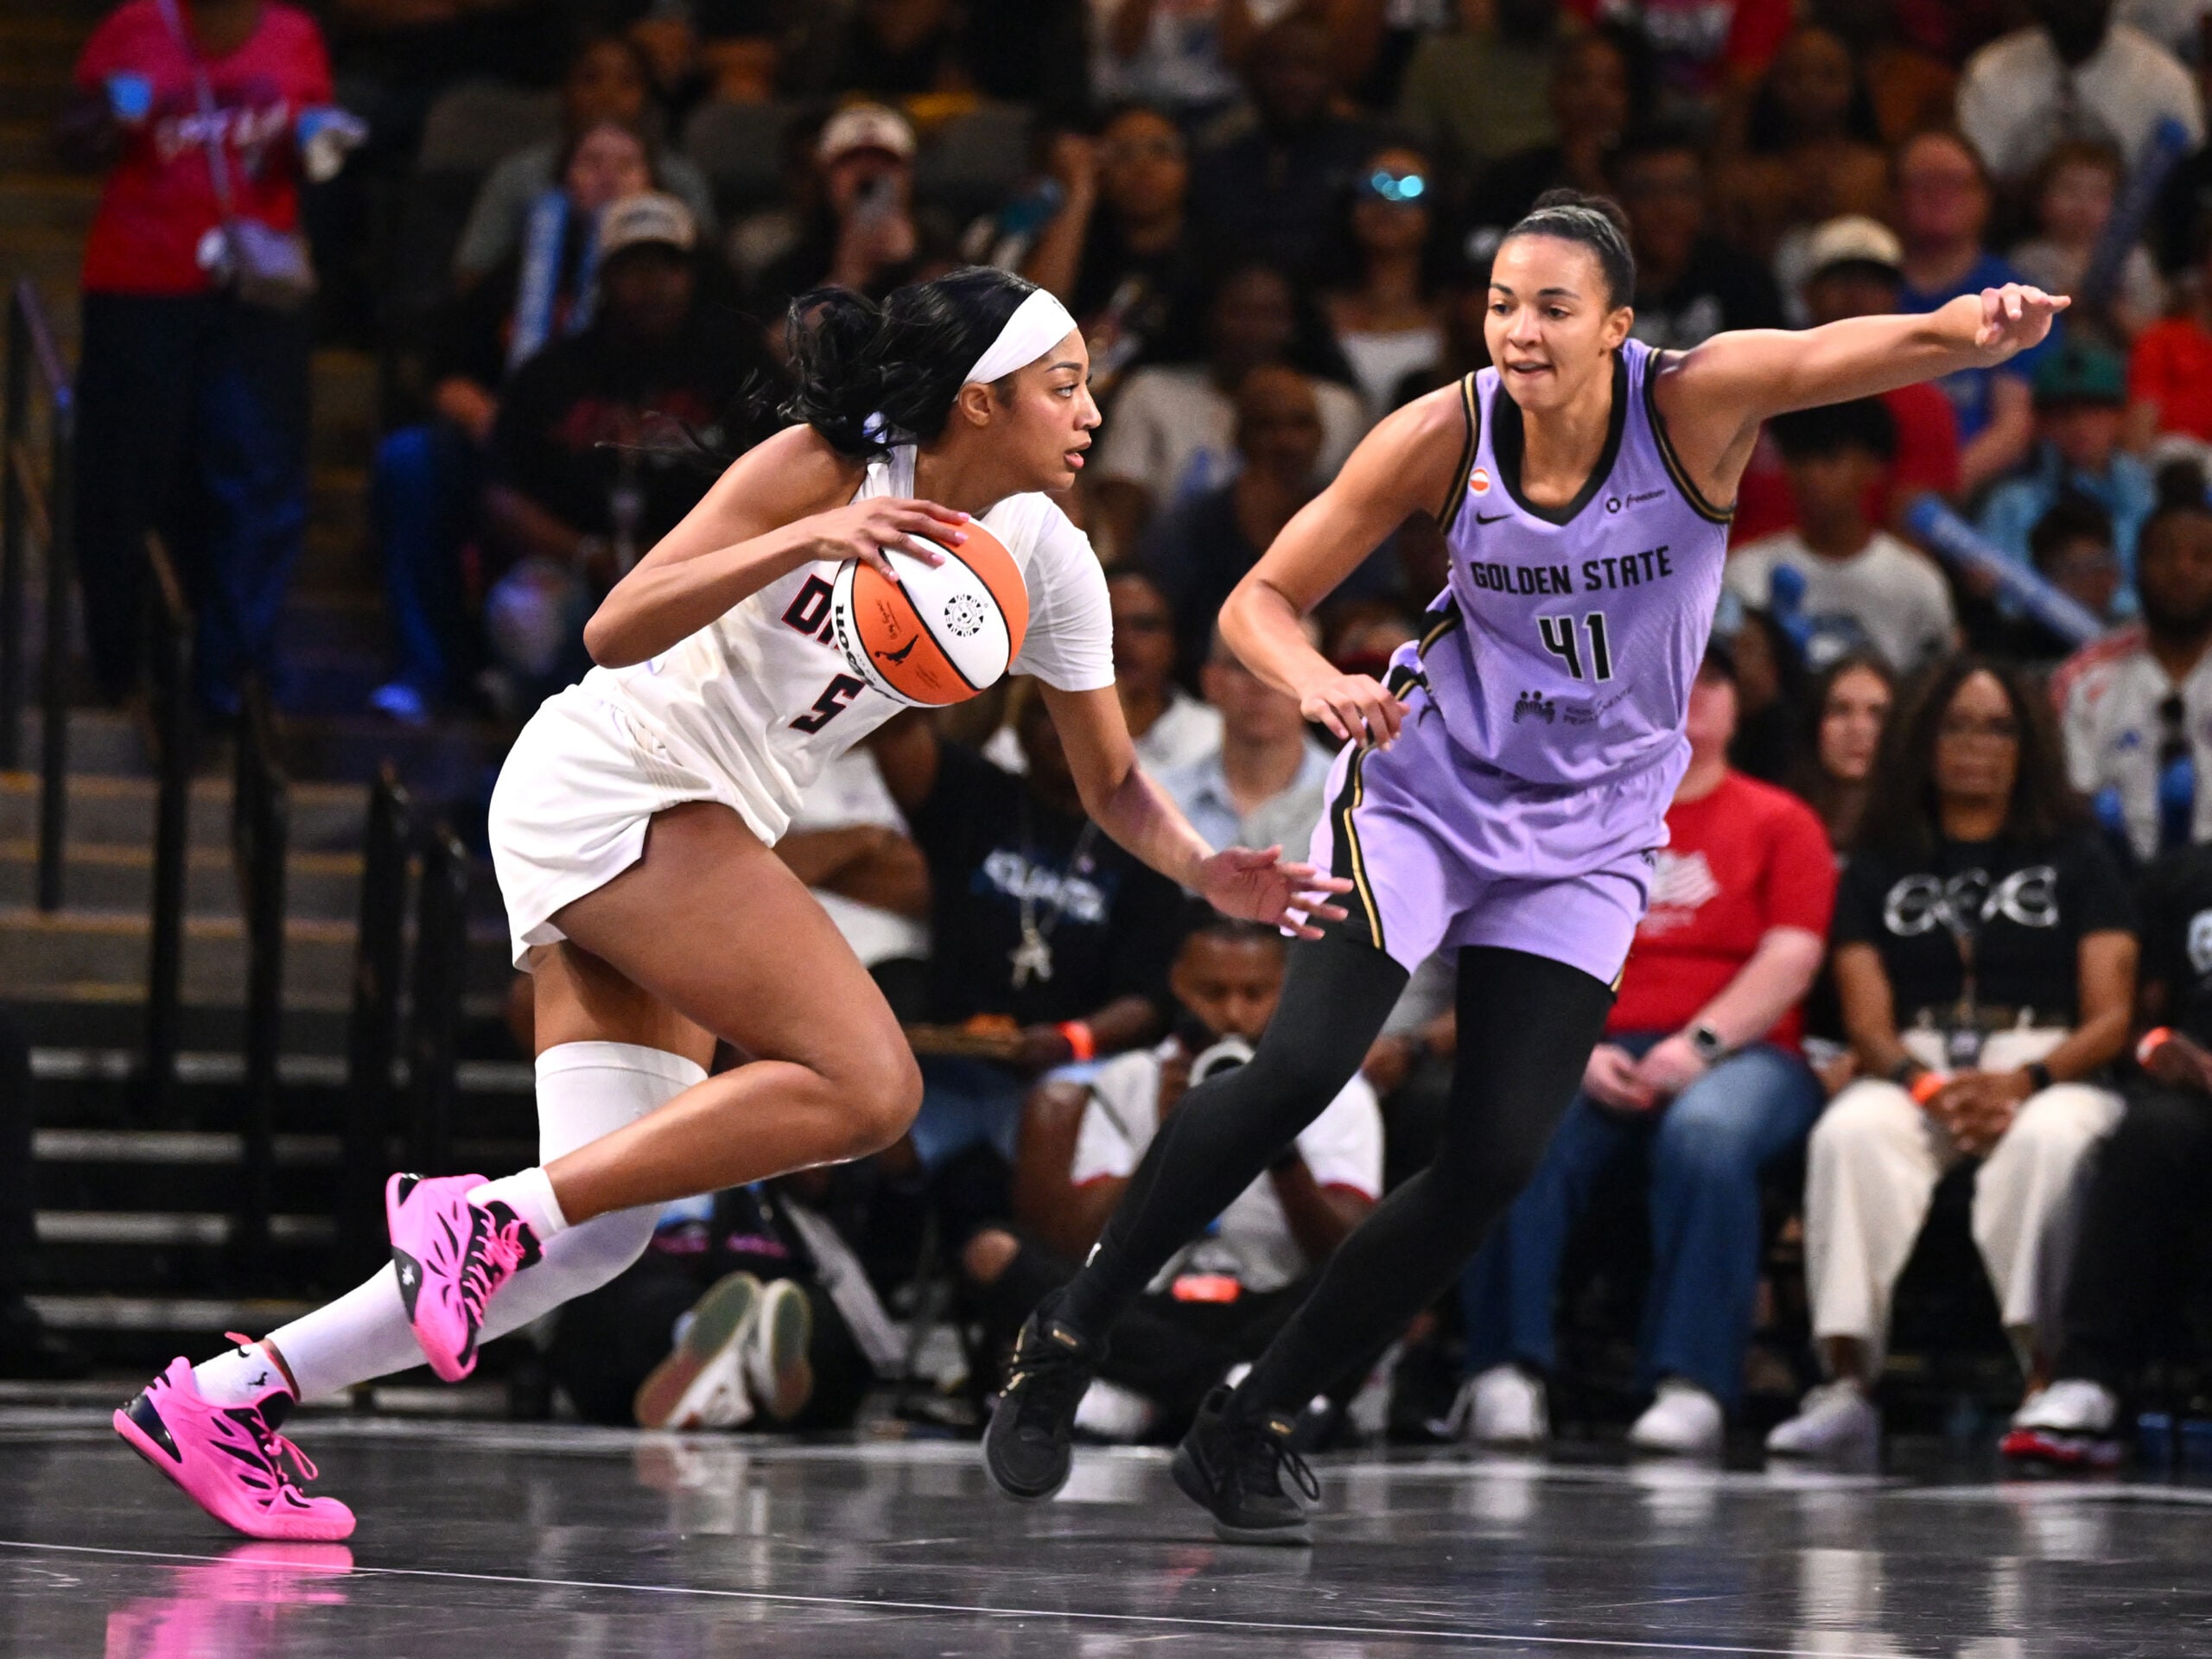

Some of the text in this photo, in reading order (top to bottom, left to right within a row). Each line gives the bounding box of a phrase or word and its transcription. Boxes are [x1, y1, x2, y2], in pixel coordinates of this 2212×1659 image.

[1470, 545, 1673, 594] GOLDEN STATE
[1536, 611, 1612, 682] 41
[788, 673, 865, 734] 5
